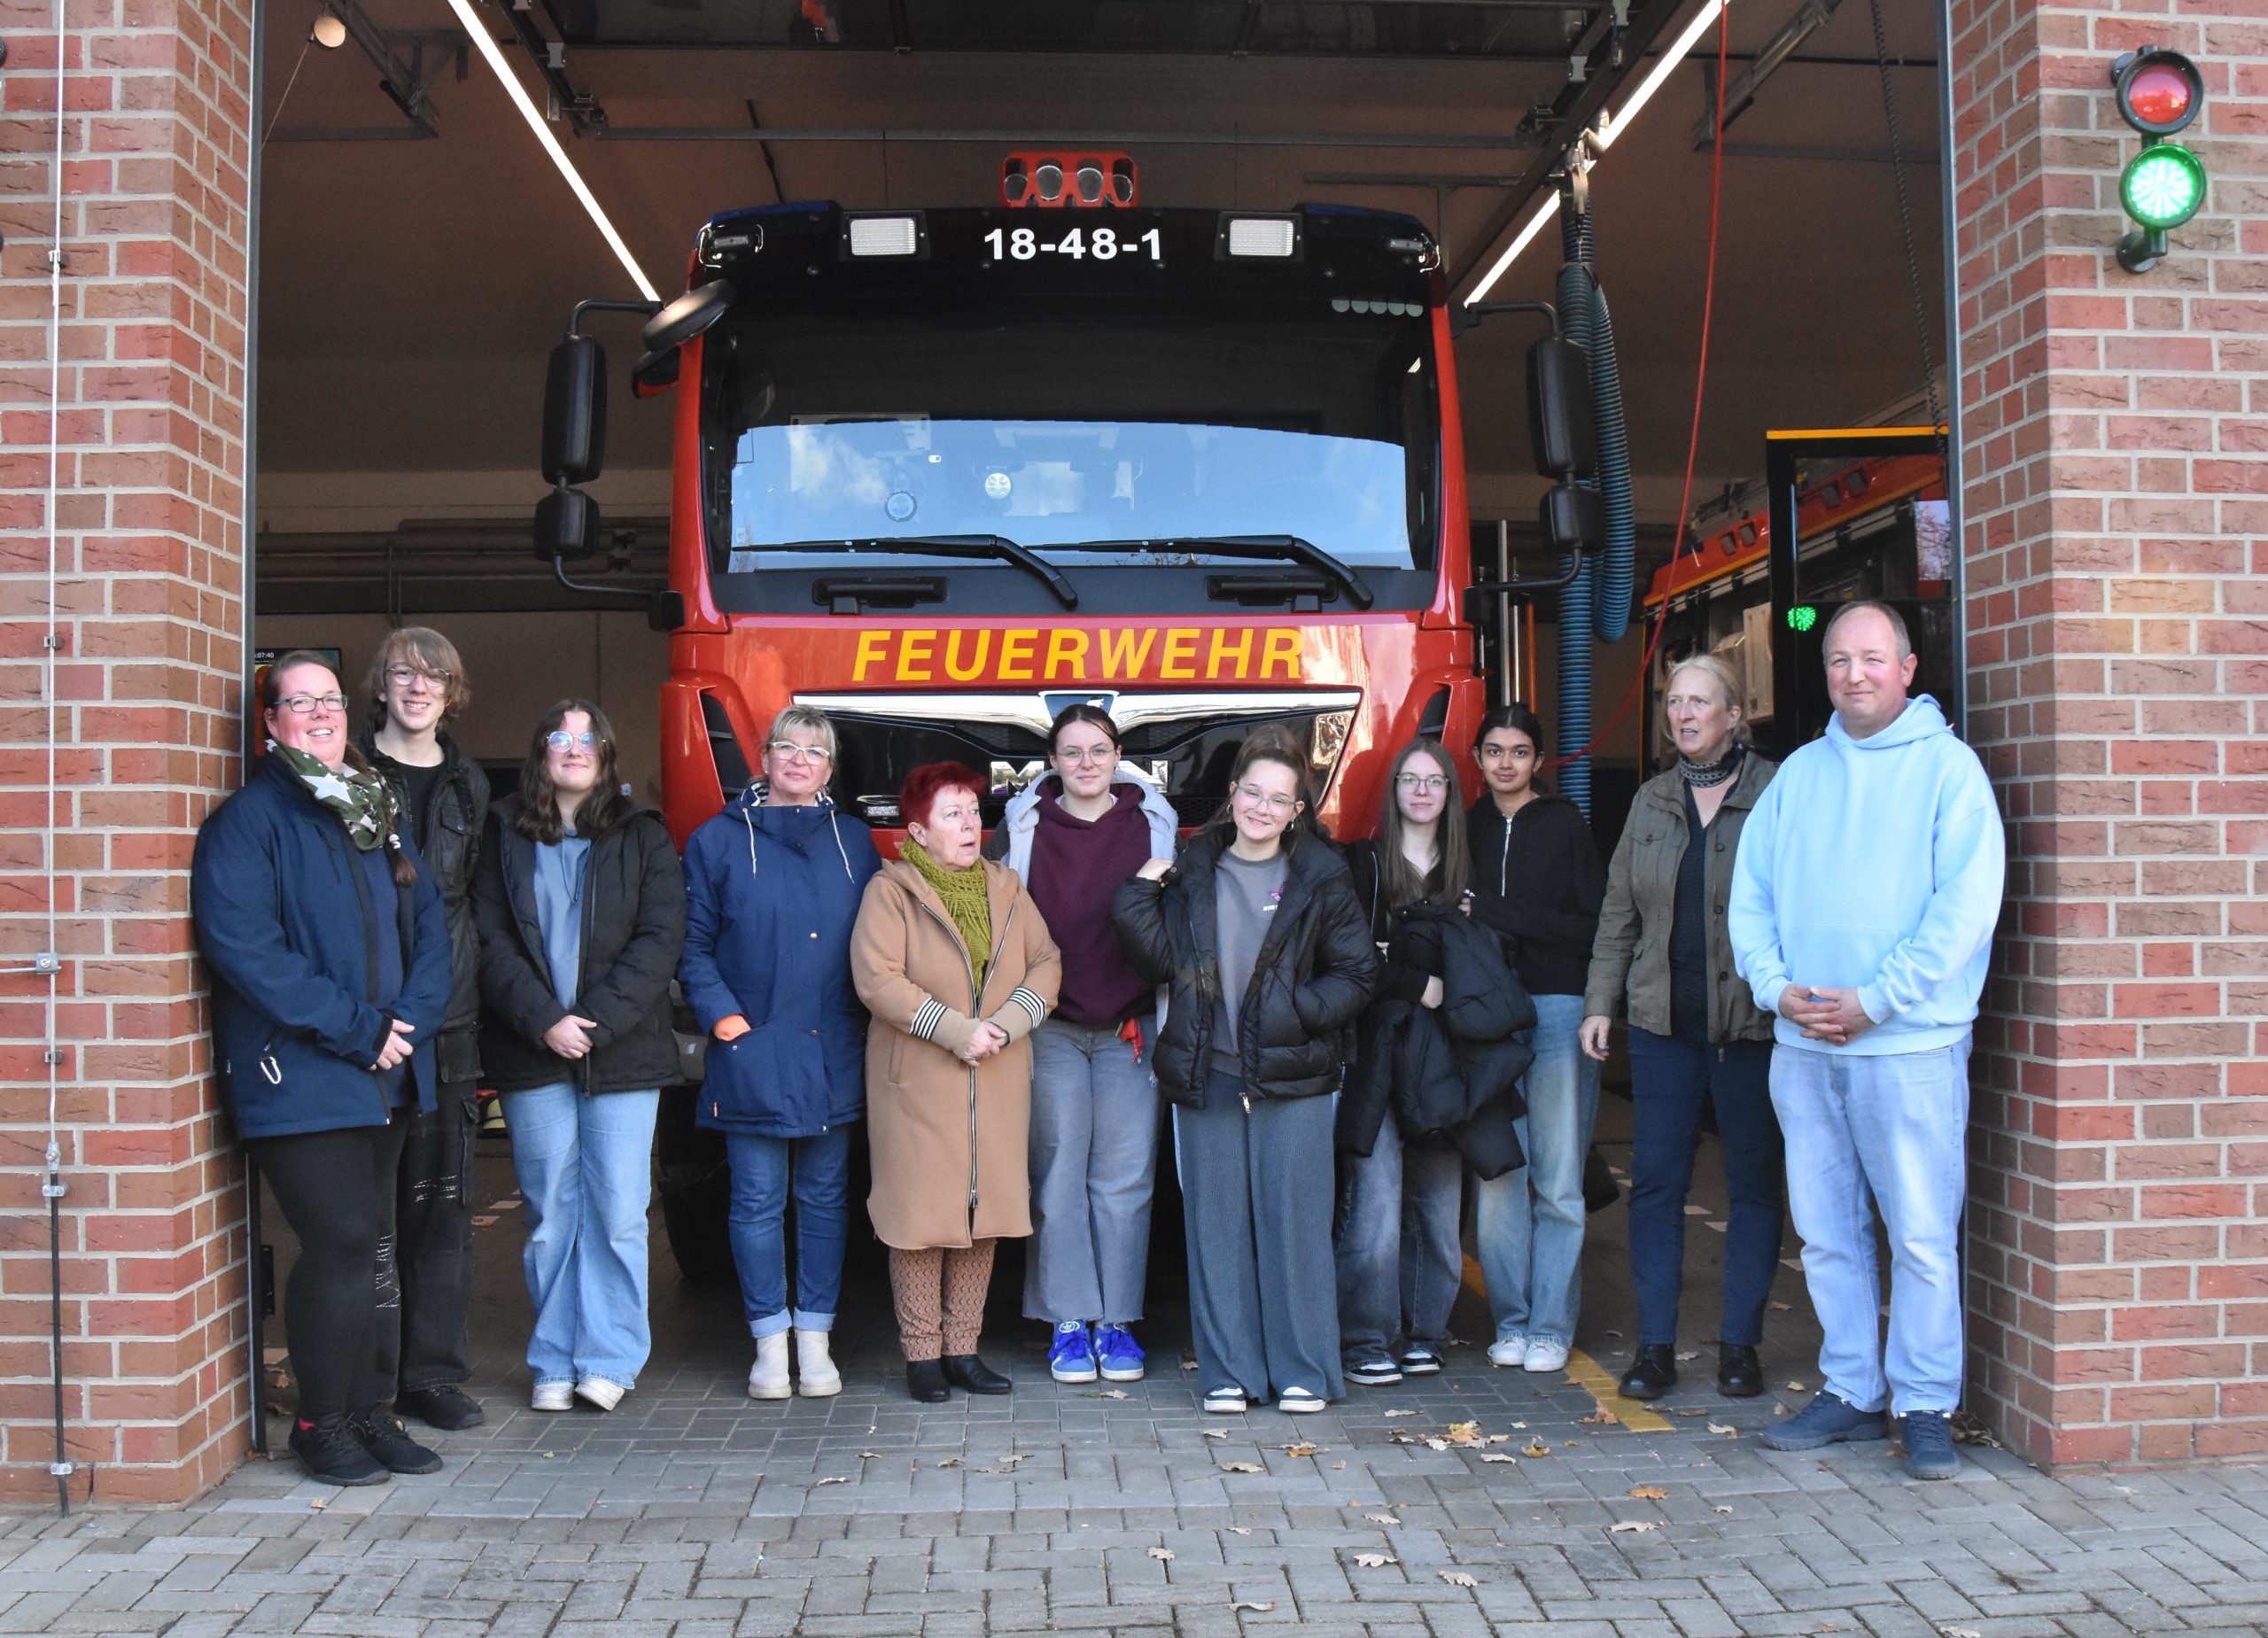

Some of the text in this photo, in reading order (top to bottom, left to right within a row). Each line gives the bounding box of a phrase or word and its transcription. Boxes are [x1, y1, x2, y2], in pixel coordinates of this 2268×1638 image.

[984, 229, 1161, 260] 18-48-1
[852, 629, 1305, 682] FEUERWEHR
[990, 760, 1169, 795] MN
